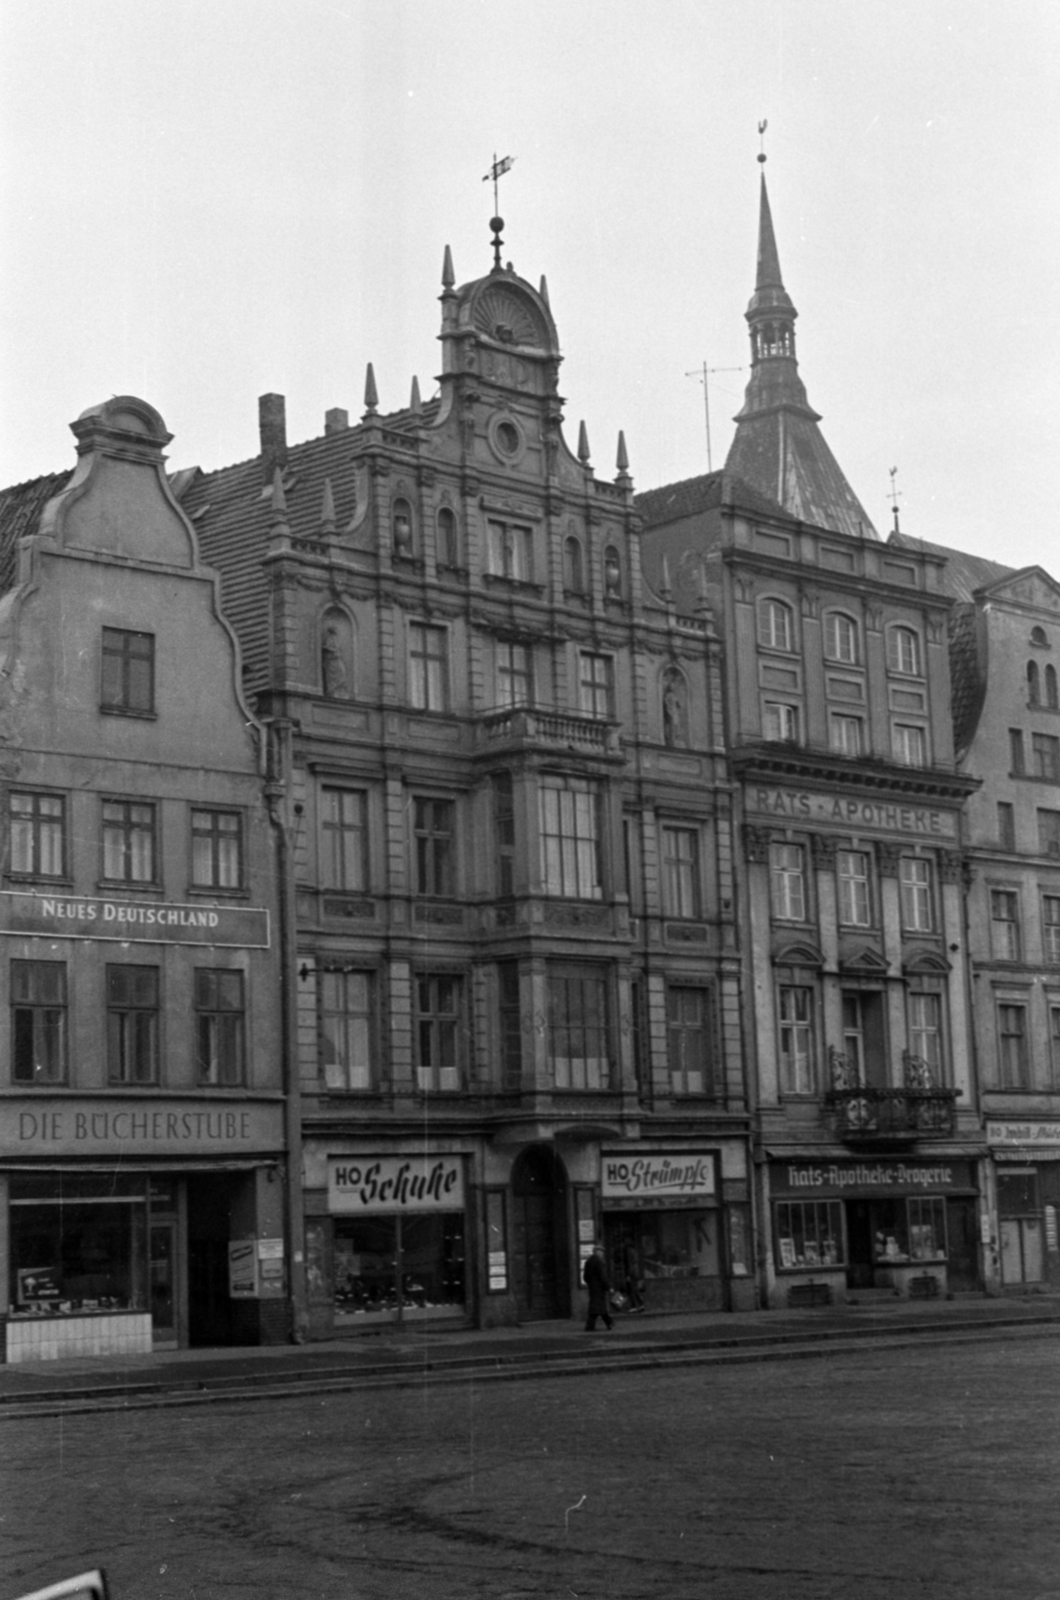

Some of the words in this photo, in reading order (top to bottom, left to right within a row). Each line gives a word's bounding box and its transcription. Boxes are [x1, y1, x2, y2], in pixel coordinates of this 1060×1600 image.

[756, 788, 811, 815] RATS
[831, 799, 941, 833] APOTHEKE
[42, 899, 97, 920] NEUES
[103, 903, 219, 928] DEUTSCHLAND
[19, 1112, 63, 1141] DIE
[75, 1112, 250, 1140] BÜCHERSTUBE
[335, 1166, 362, 1186] HO
[360, 1161, 457, 1205] Schuhe
[607, 1163, 629, 1181] HO
[626, 1159, 708, 1191] Strümpfe
